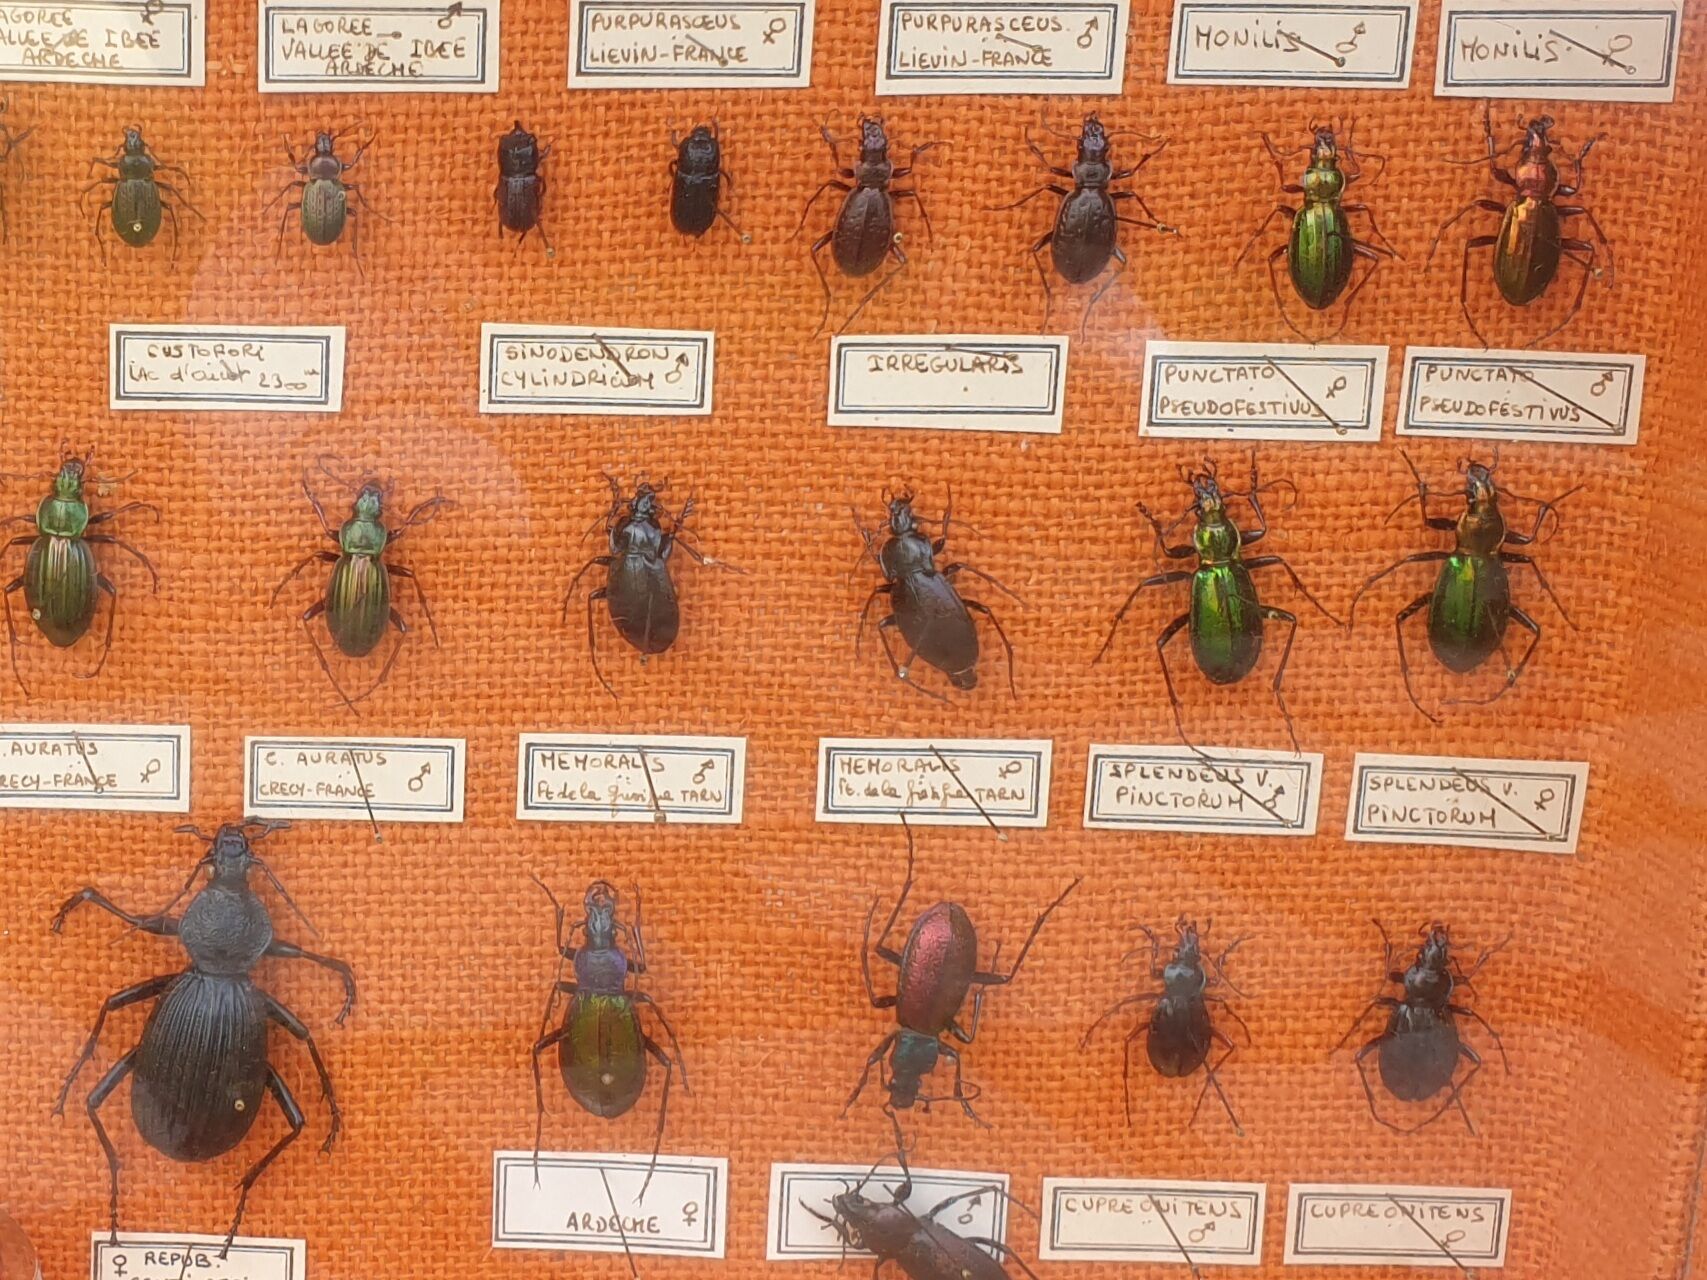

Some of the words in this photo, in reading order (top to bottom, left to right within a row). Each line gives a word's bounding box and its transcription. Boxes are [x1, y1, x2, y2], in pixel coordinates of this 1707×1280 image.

[1164, 365, 1275, 384] PUNCTATO
[11, 741, 98, 756] AURATUS
[297, 751, 387, 766] AURATUS
[540, 752, 665, 772] MEMORALS
[680, 790, 722, 803] TARN
[974, 788, 1025, 803] TARN
